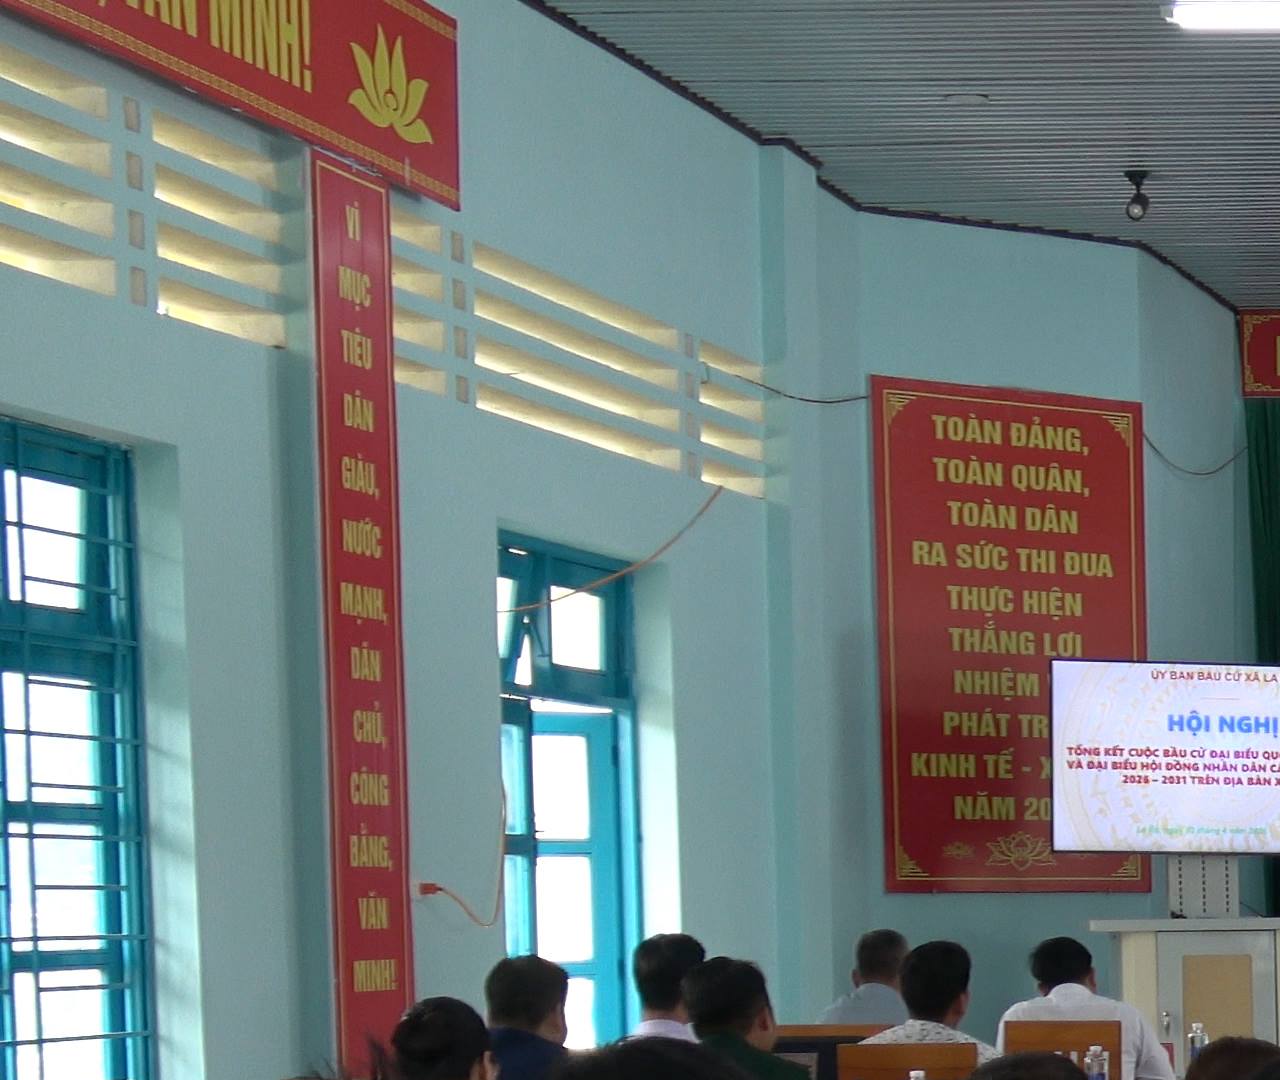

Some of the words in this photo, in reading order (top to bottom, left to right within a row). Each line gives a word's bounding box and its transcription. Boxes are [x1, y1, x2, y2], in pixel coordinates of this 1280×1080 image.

[345, 201, 361, 241] VÌ
[338, 265, 371, 311] MỤC
[341, 327, 372, 370] TIÊU
[343, 390, 374, 432] DÂN
[931, 413, 1002, 445] TOÀN
[1010, 416, 1089, 456] ĐẢNG,
[341, 453, 380, 499] GIÀU,
[932, 455, 1003, 487] TOÀN
[1011, 463, 1090, 497] QUÂN,
[947, 498, 1017, 530] TOÀN
[1025, 504, 1078, 534] DÂN
[342, 518, 382, 559] NƯỚC
[912, 541, 948, 567] RA
[956, 540, 1009, 571] SỨC
[1016, 548, 1056, 574] THI
[1063, 551, 1113, 578] ĐUA
[340, 582, 388, 625] MẠNH,
[947, 585, 1014, 617] THỰC
[1023, 587, 1083, 620] HIỆN
[948, 621, 1035, 655] THẮNG
[351, 641, 381, 682] DÂN
[1170, 670, 1194, 680] BAN
[1244, 670, 1260, 682] XÃ
[1264, 673, 1278, 683] LA
[953, 667, 1040, 701] NHIỆM
[353, 701, 387, 750] CHỦ,
[943, 708, 1010, 737] PHÁT
[1168, 710, 1210, 736] HỘI
[1219, 715, 1278, 738] NGHỊ
[911, 752, 976, 778] KINH
[983, 747, 1014, 779] TẾ
[1066, 744, 1100, 756] TỔNG
[1104, 745, 1125, 757] KẾT
[1128, 748, 1160, 759] CUỘC
[1163, 746, 1187, 758] BẦU
[1210, 749, 1230, 761] ĐẠI
[1066, 758, 1084, 769] VÀ
[1087, 761, 1108, 772] ĐẠI
[1141, 760, 1162, 772] HỘI
[1165, 760, 1199, 771] ĐỒNG
[1203, 761, 1238, 773] NHÂN
[1241, 762, 1266, 773] DÂN
[351, 767, 390, 806] CÔNG
[1161, 775, 1187, 785] 2031
[1190, 774, 1219, 785] TRÊN
[1223, 777, 1243, 787] ĐỊA
[1247, 775, 1271, 786] BÀN
[954, 791, 1015, 820] NĂM
[358, 890, 389, 929] VĂN
[353, 959, 398, 992] MINH!
